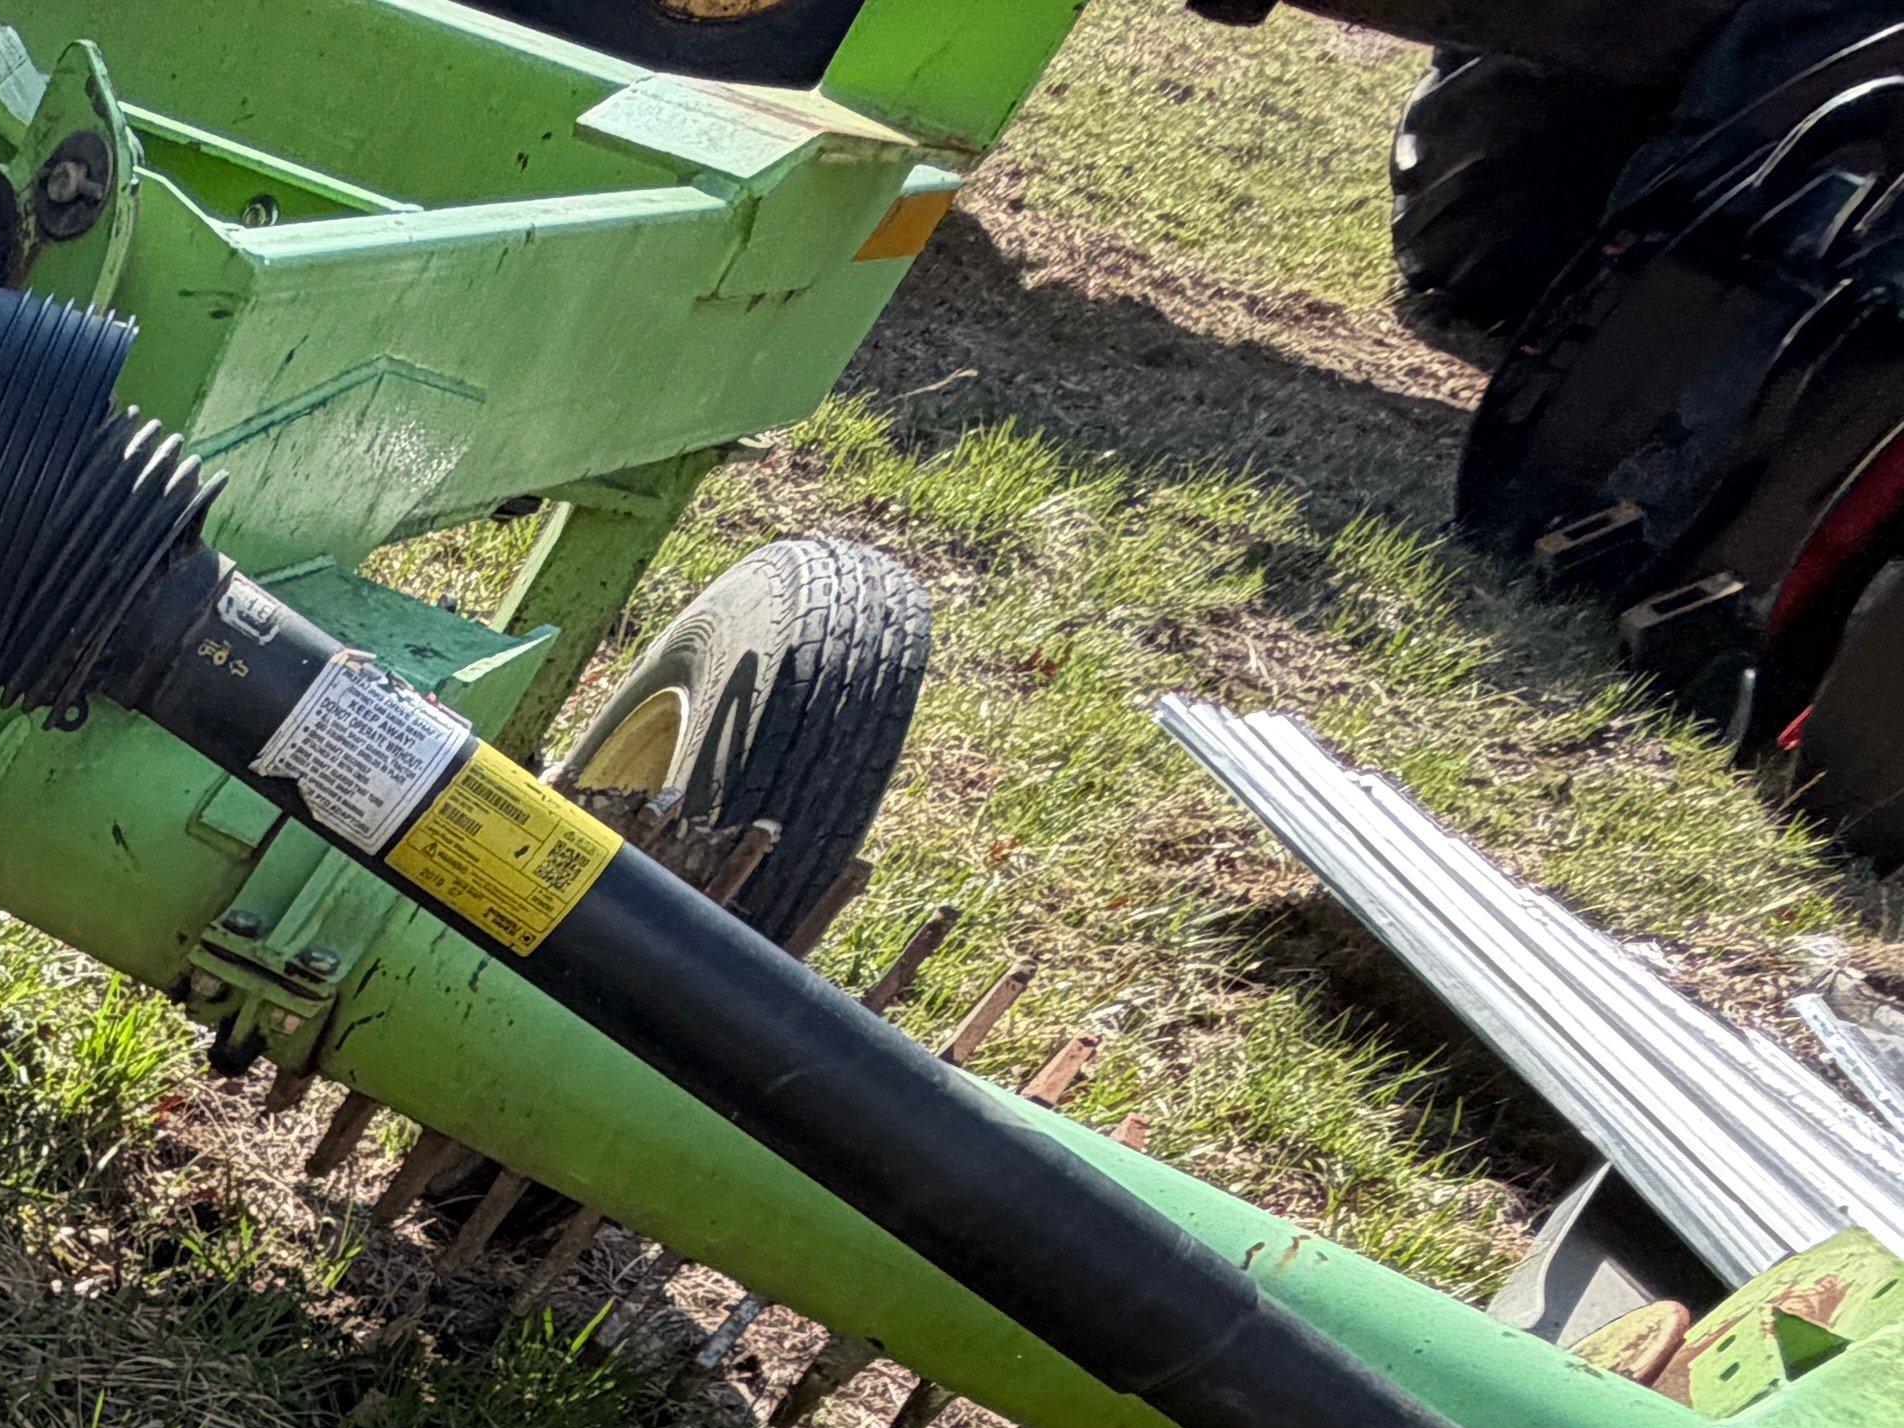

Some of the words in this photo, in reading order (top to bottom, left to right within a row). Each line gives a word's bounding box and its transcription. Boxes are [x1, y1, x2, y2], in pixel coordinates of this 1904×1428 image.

[318, 696, 336, 712] DO
[330, 704, 352, 723] NOT
[347, 716, 387, 747] OPERATE
[346, 699, 380, 725] KEEP
[377, 720, 416, 749] AWAY!
